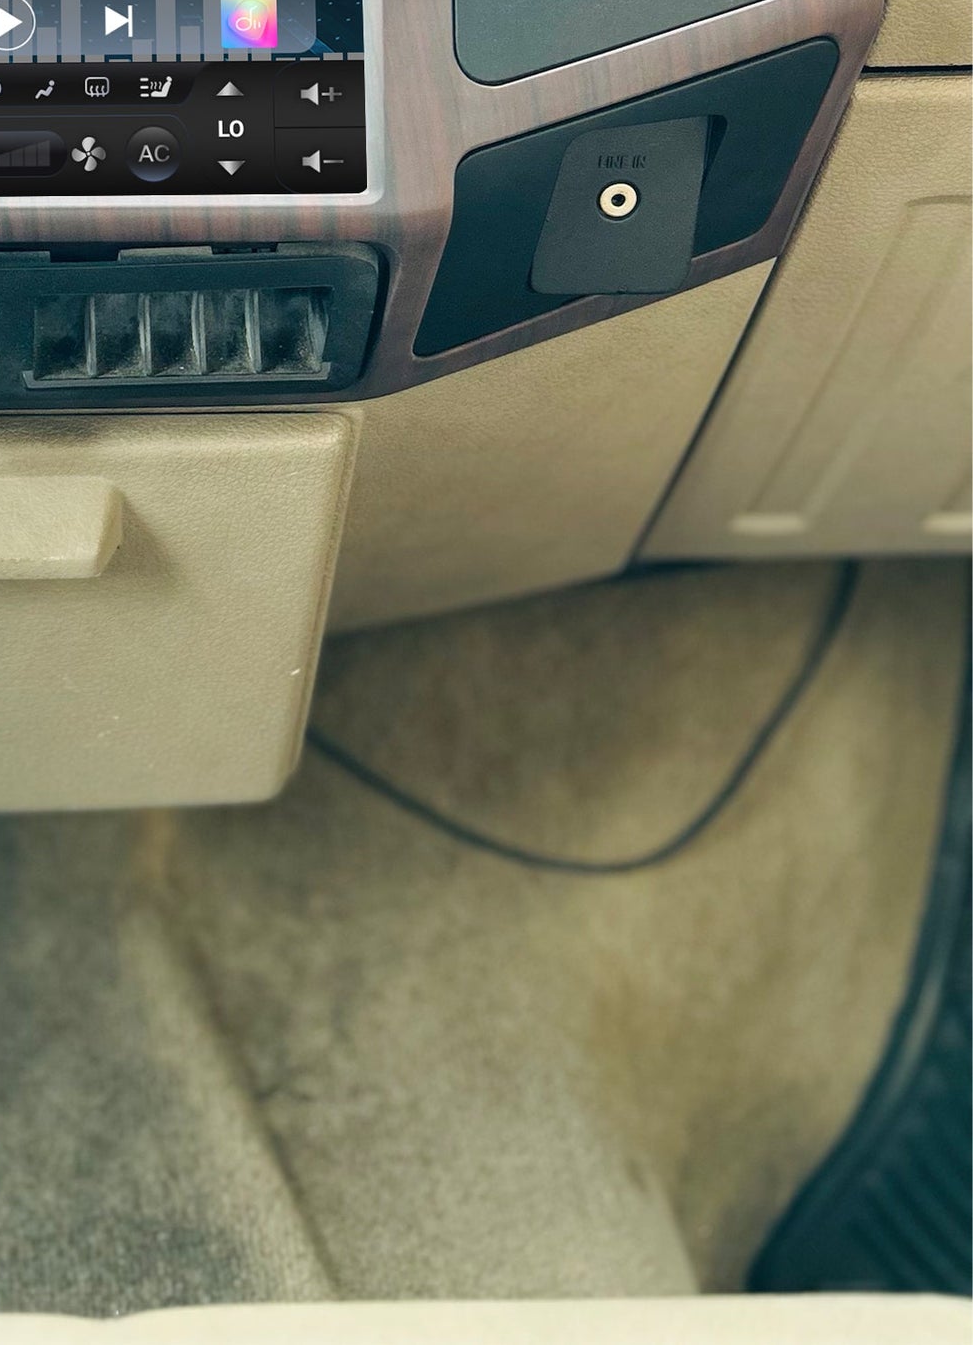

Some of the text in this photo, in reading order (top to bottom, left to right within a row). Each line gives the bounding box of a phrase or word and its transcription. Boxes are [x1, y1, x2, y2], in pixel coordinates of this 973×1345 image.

[218, 120, 244, 137] LO
[138, 144, 170, 162] AC
[598, 154, 647, 169] LINE IN
